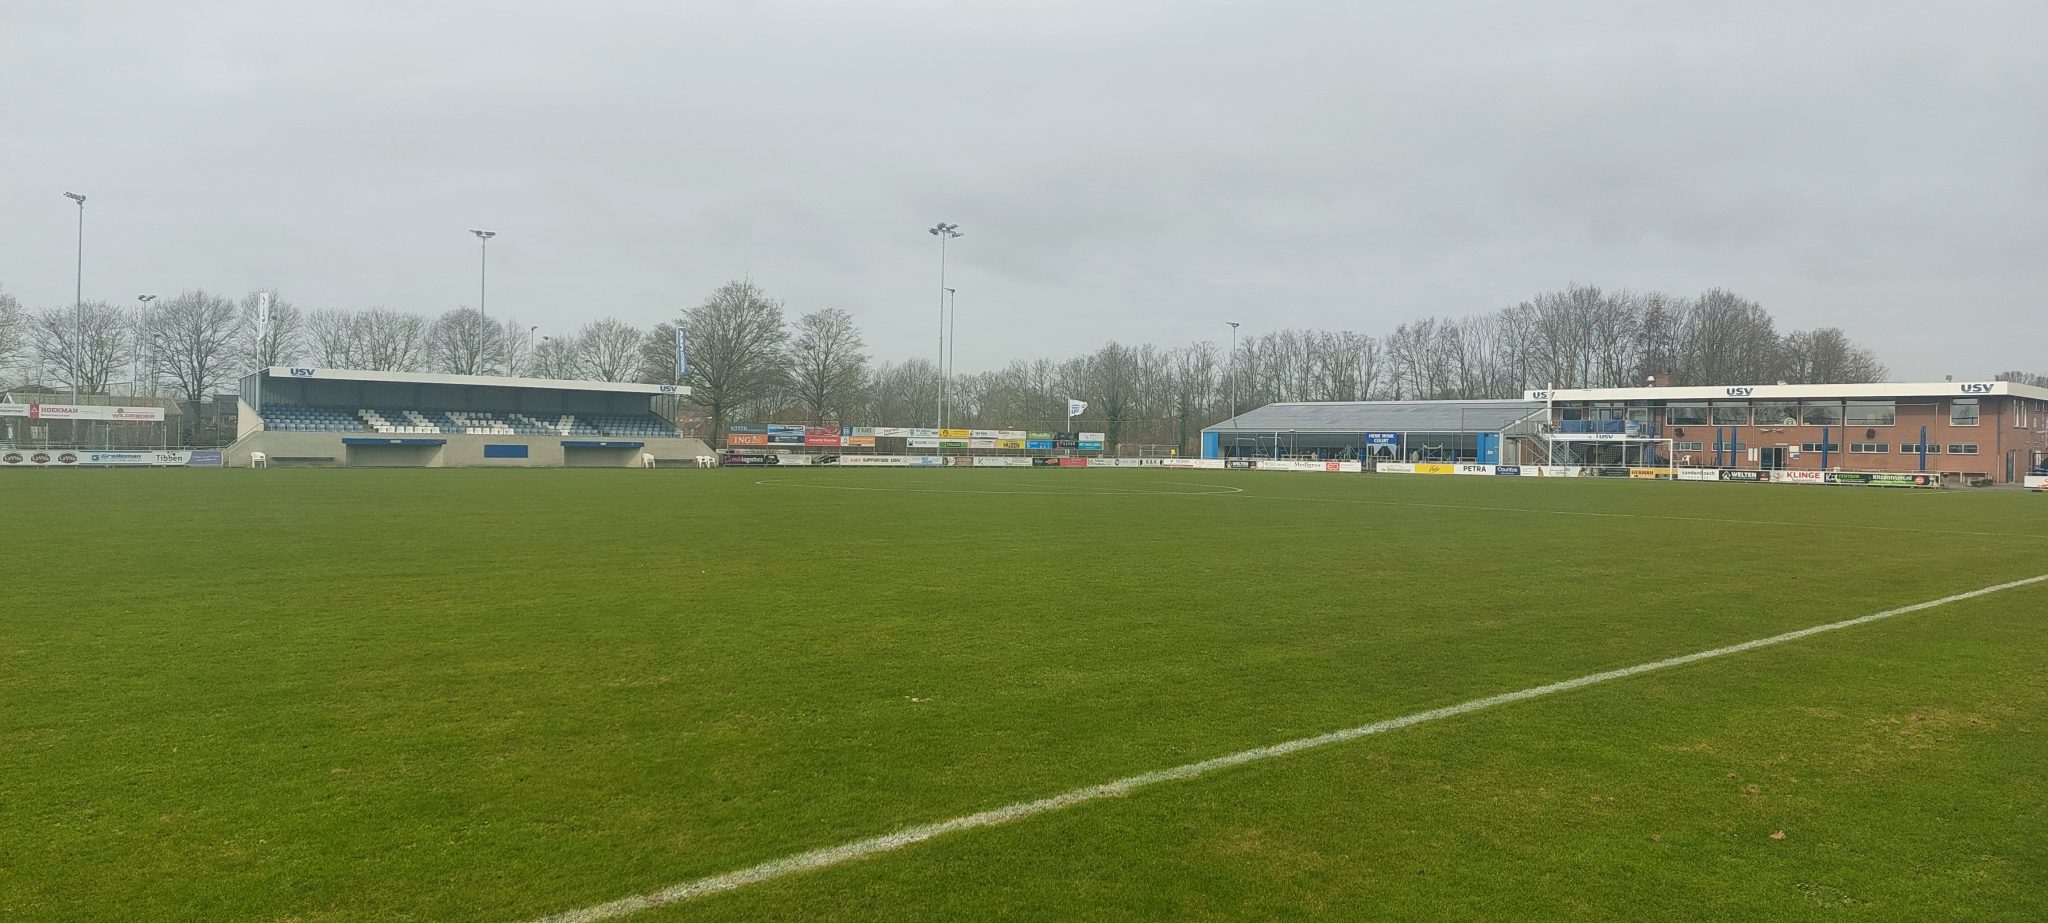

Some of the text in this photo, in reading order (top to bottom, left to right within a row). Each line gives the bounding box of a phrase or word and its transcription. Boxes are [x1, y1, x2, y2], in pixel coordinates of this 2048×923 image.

[290, 368, 316, 376] USV
[1727, 388, 1754, 396] USV
[1961, 384, 1994, 393] USV
[734, 436, 751, 444] ING
[156, 454, 183, 462] Tibben
[1463, 465, 1486, 473] PETRA
